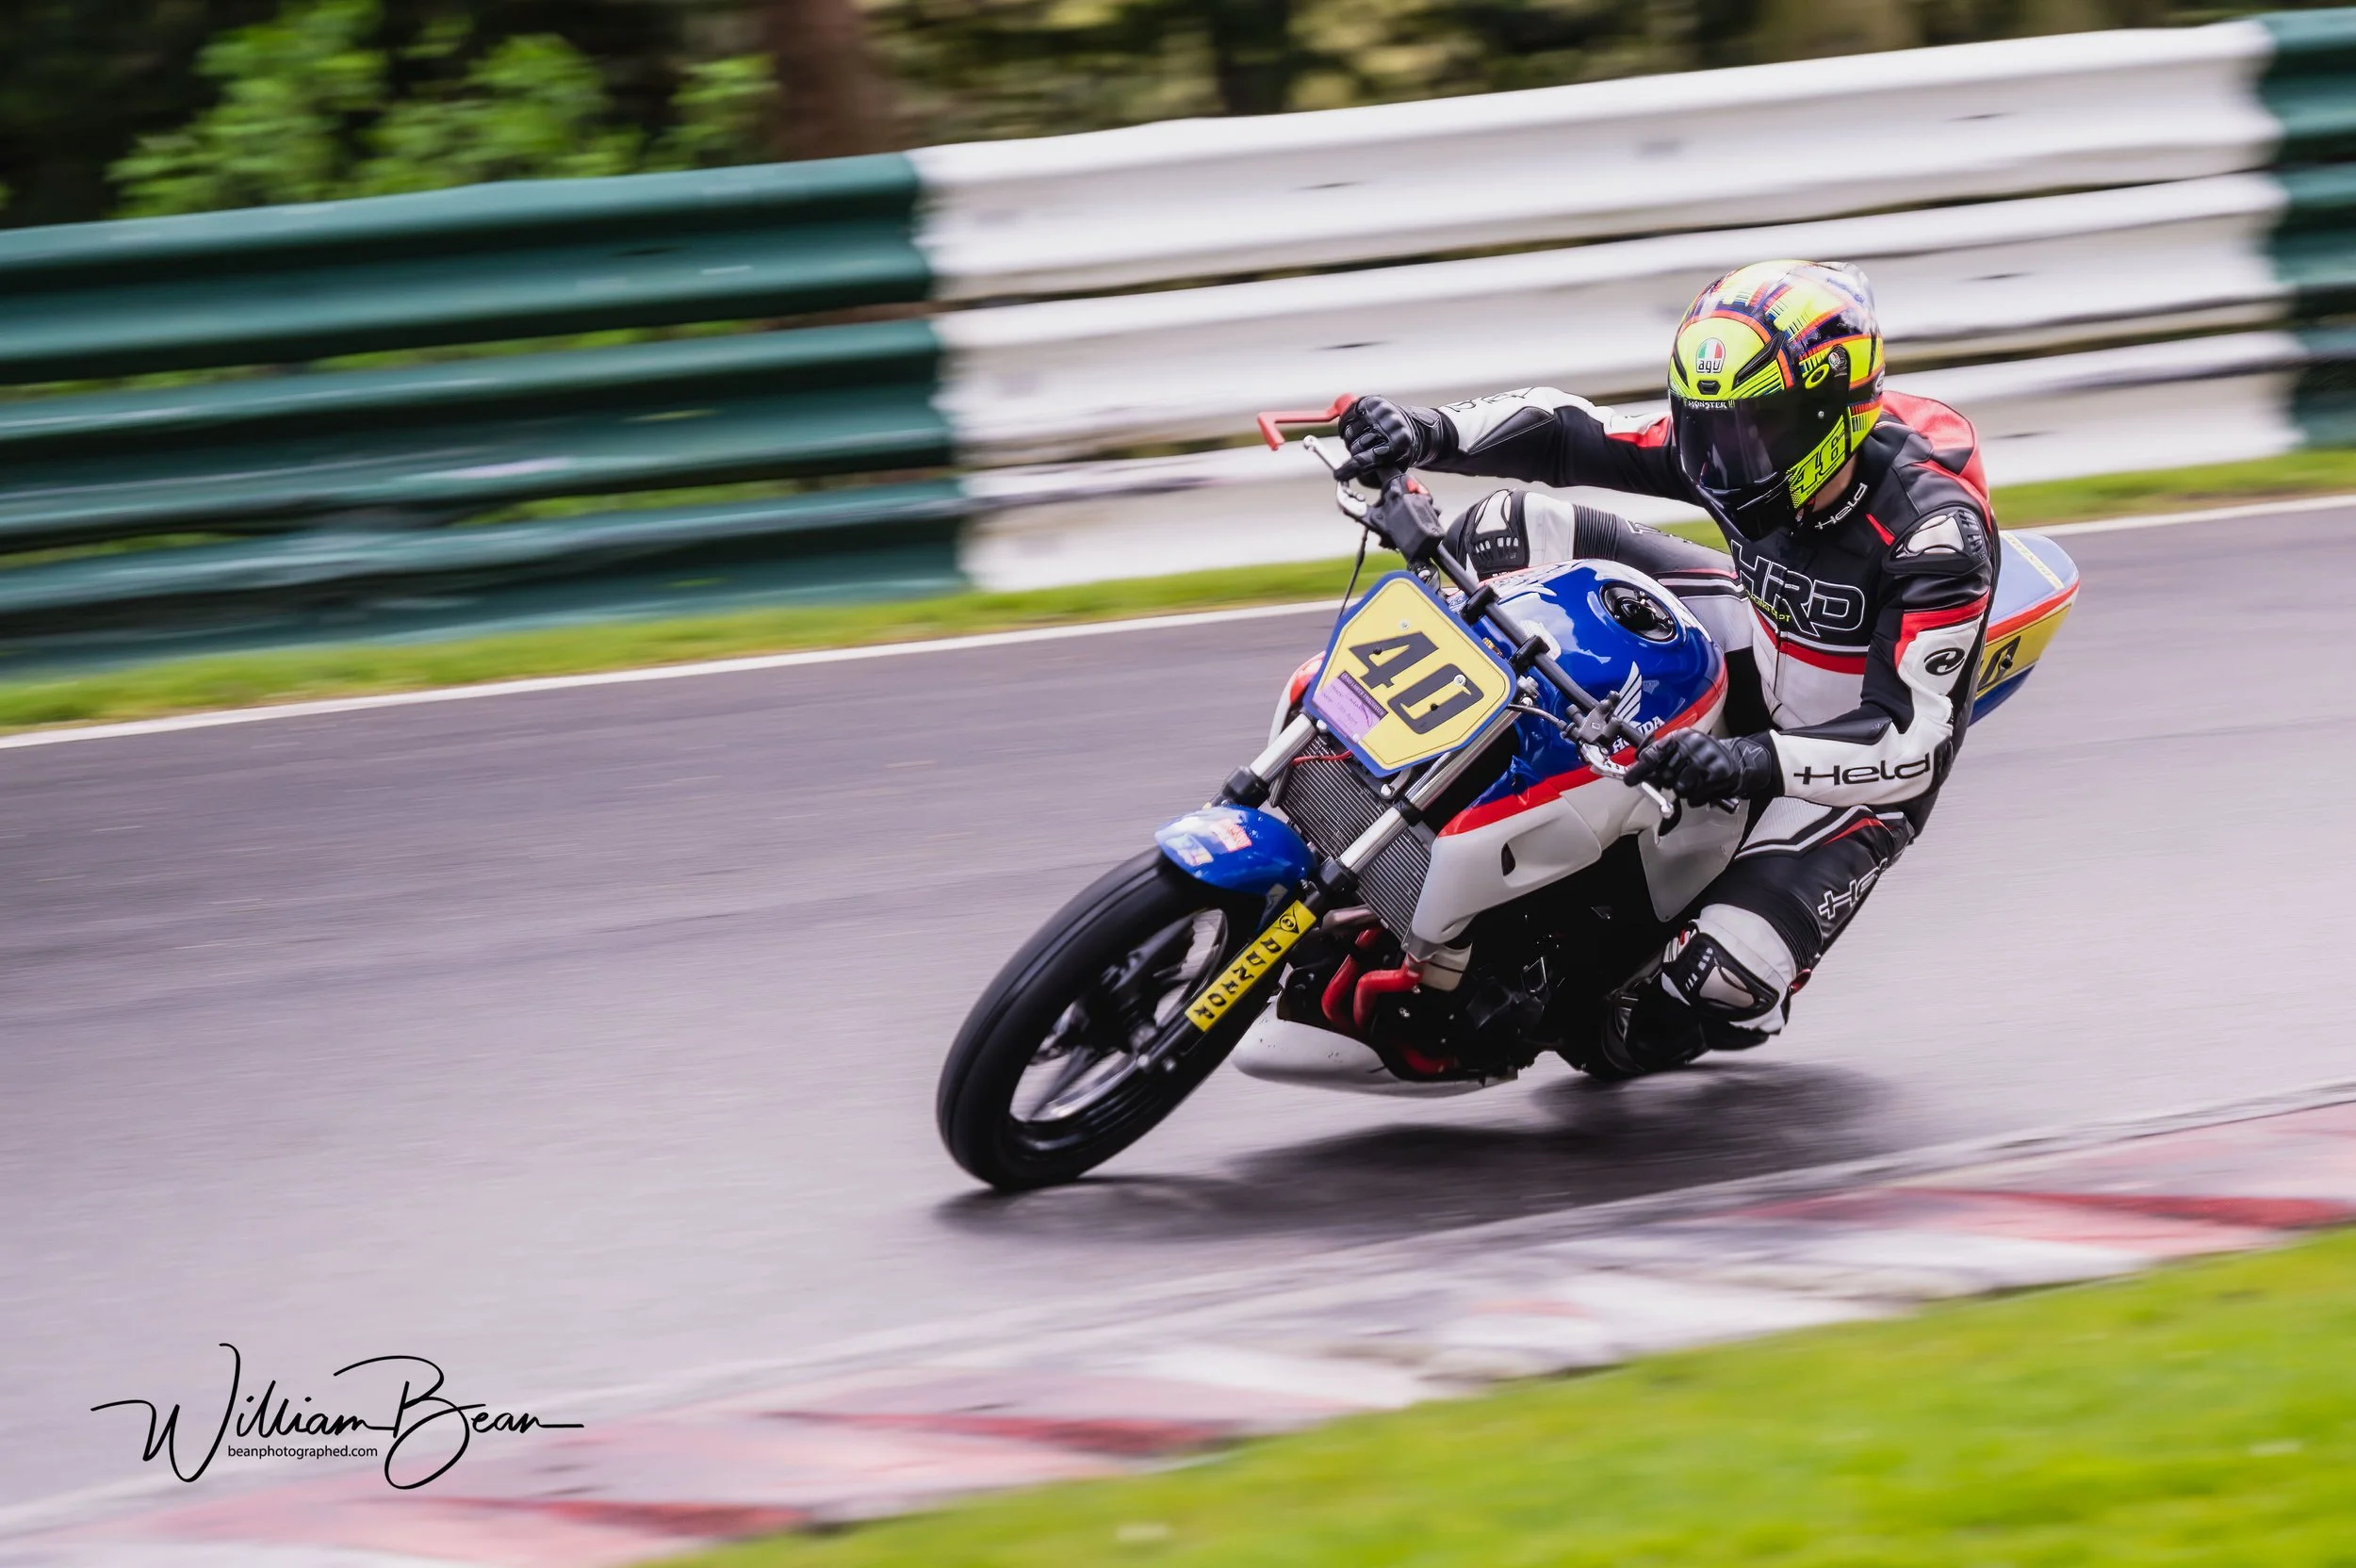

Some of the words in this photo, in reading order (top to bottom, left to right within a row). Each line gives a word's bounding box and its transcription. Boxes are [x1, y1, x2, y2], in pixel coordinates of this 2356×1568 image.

[1688, 400, 1727, 410] MONSTER
[1792, 420, 1845, 494] 46
[1814, 482, 1868, 530] Held
[1348, 630, 1485, 735] 40
[1792, 752, 1931, 785] Held
[1194, 937, 1282, 1021] DUNLOP
